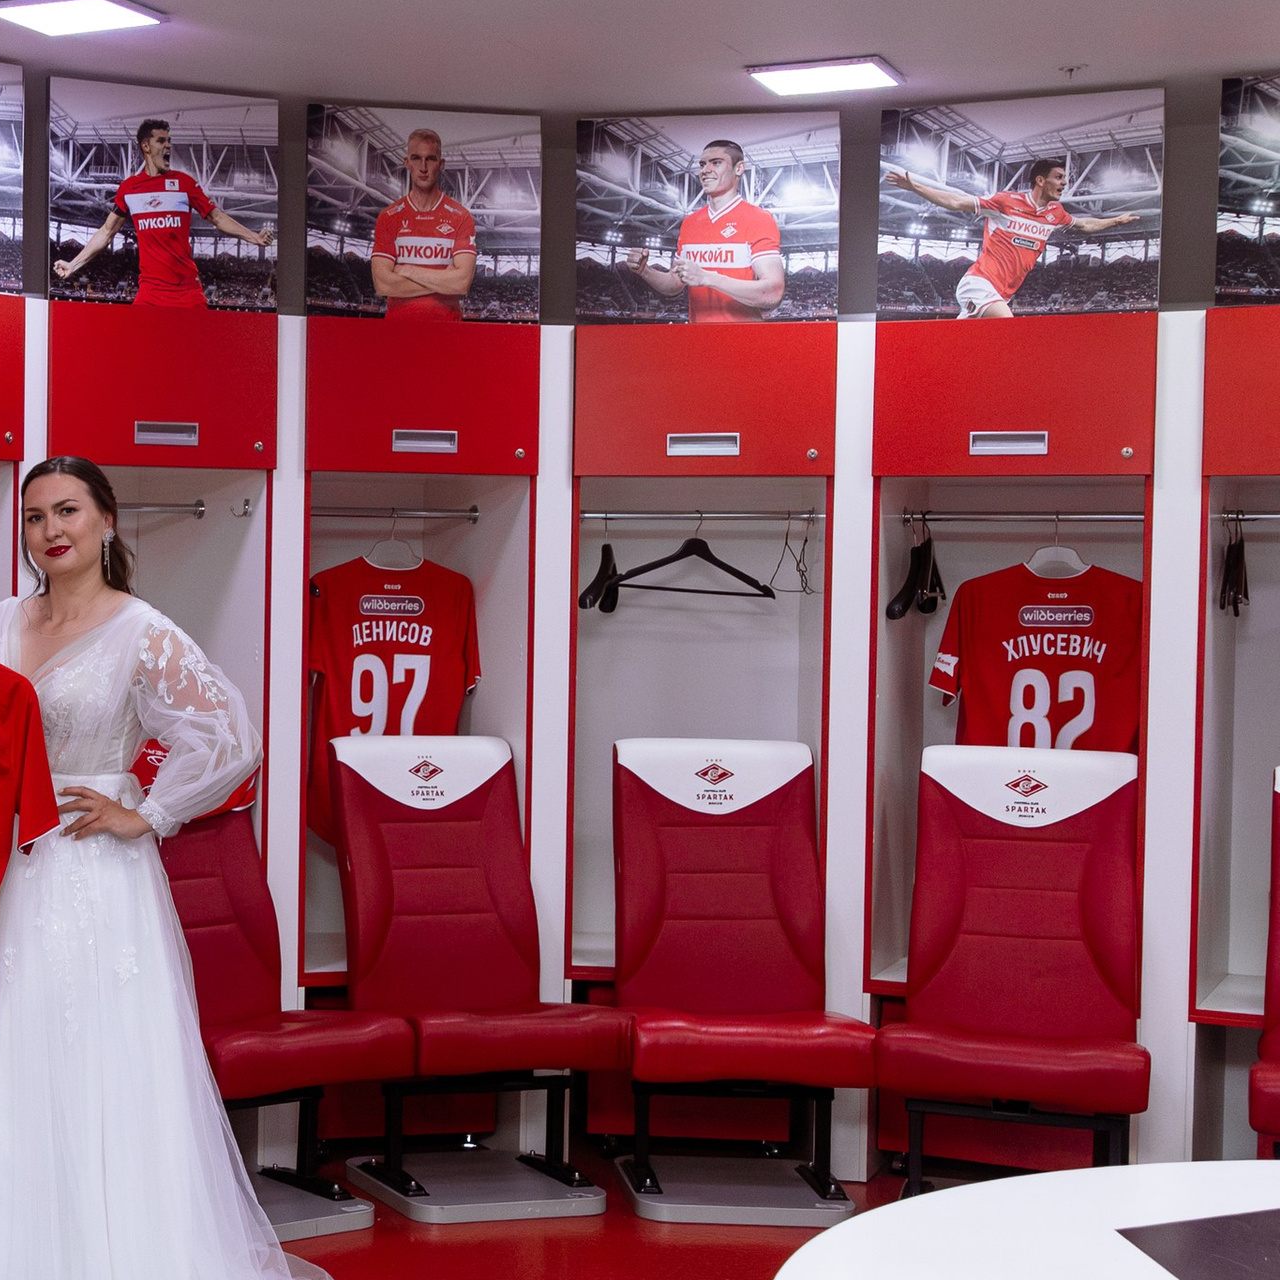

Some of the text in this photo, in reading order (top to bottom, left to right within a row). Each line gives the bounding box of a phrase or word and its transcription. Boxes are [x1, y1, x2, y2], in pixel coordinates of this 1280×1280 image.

[138, 214, 181, 231] ЛУКОЙЛ
[398, 243, 452, 259] ЛУКОЙЛ
[685, 247, 734, 263] ЛУКОЙЛ
[362, 599, 420, 611] wildberries
[1023, 609, 1091, 621] wildberries
[352, 620, 433, 648] ДЕНИСОВ
[1002, 633, 1107, 664] ХЛУСЕВИЧ
[350, 653, 431, 736] 97
[1007, 668, 1095, 749] 82
[1005, 805, 1047, 814] SPARTAK
